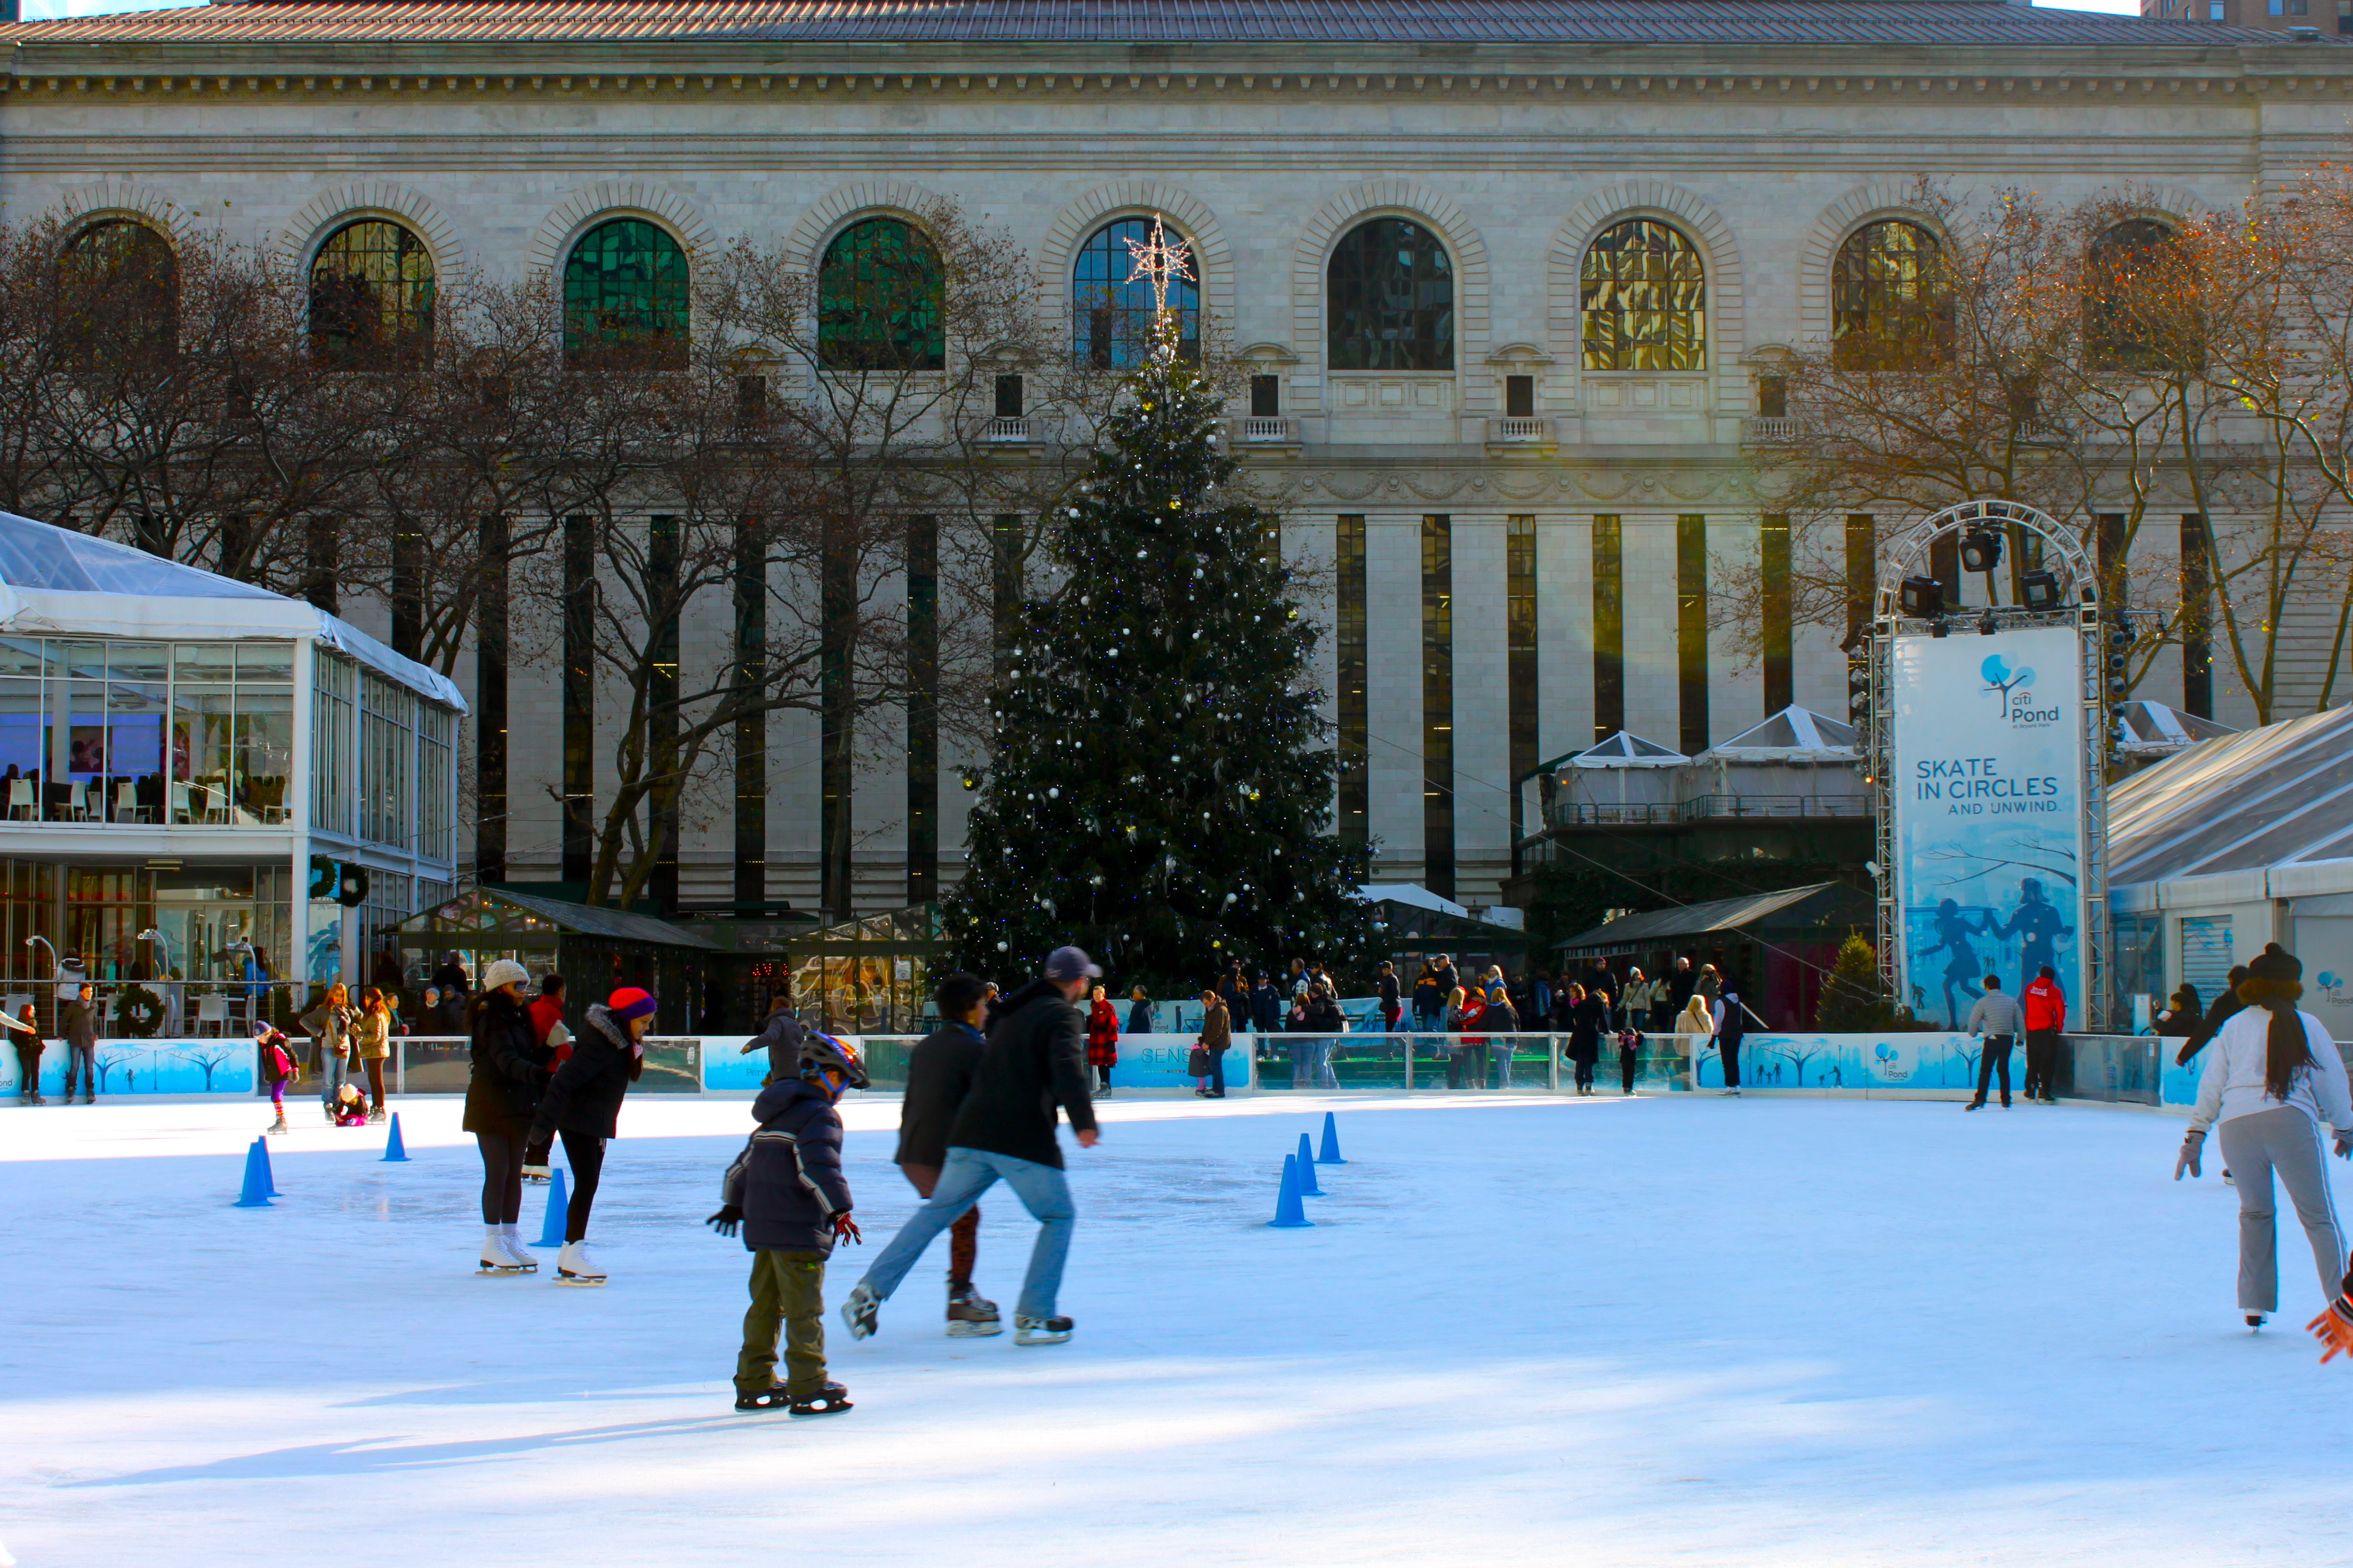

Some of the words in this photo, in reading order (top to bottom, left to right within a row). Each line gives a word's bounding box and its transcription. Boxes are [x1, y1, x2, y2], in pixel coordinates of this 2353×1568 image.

[2012, 692, 2031, 705] citi
[2012, 706, 2059, 722] Pond
[1916, 758, 1997, 779] SKATE
[1917, 782, 1940, 800] IN
[1948, 777, 2058, 799] CIRCLES
[1948, 803, 1983, 815] AND
[1991, 800, 2062, 815] UNWIND.
